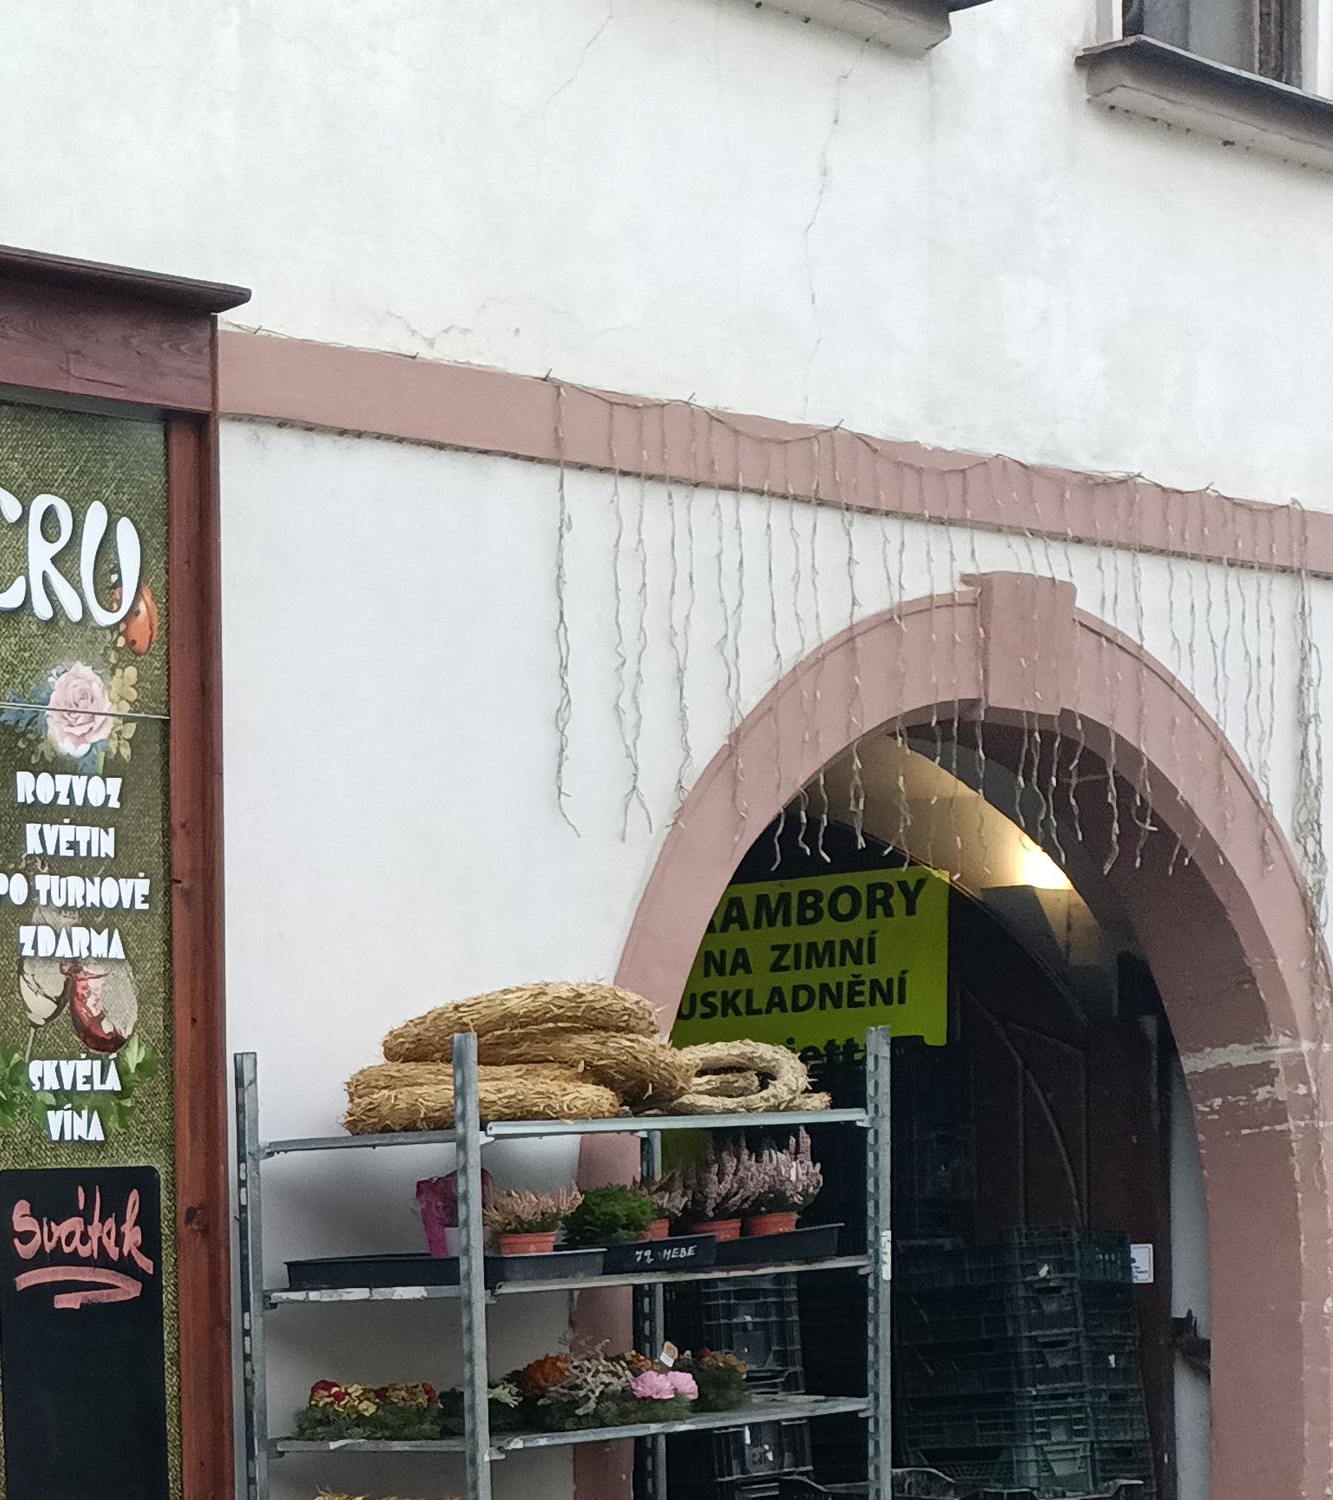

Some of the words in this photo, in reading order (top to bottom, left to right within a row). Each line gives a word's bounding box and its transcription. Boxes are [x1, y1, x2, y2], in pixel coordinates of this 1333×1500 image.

[15, 771, 123, 809] ROZVOZ
[25, 818, 115, 858] KVĚTIN
[34, 872, 151, 910] TURNOVĚ
[707, 877, 928, 933] AMBORY
[19, 925, 125, 959] ZDARMA
[703, 946, 753, 978] NA
[770, 929, 879, 974] ZIMNÍ
[28, 1053, 122, 1092] SKVĚLÁ
[46, 1105, 105, 1142] VÍNA
[11, 1184, 154, 1276] Svátek
